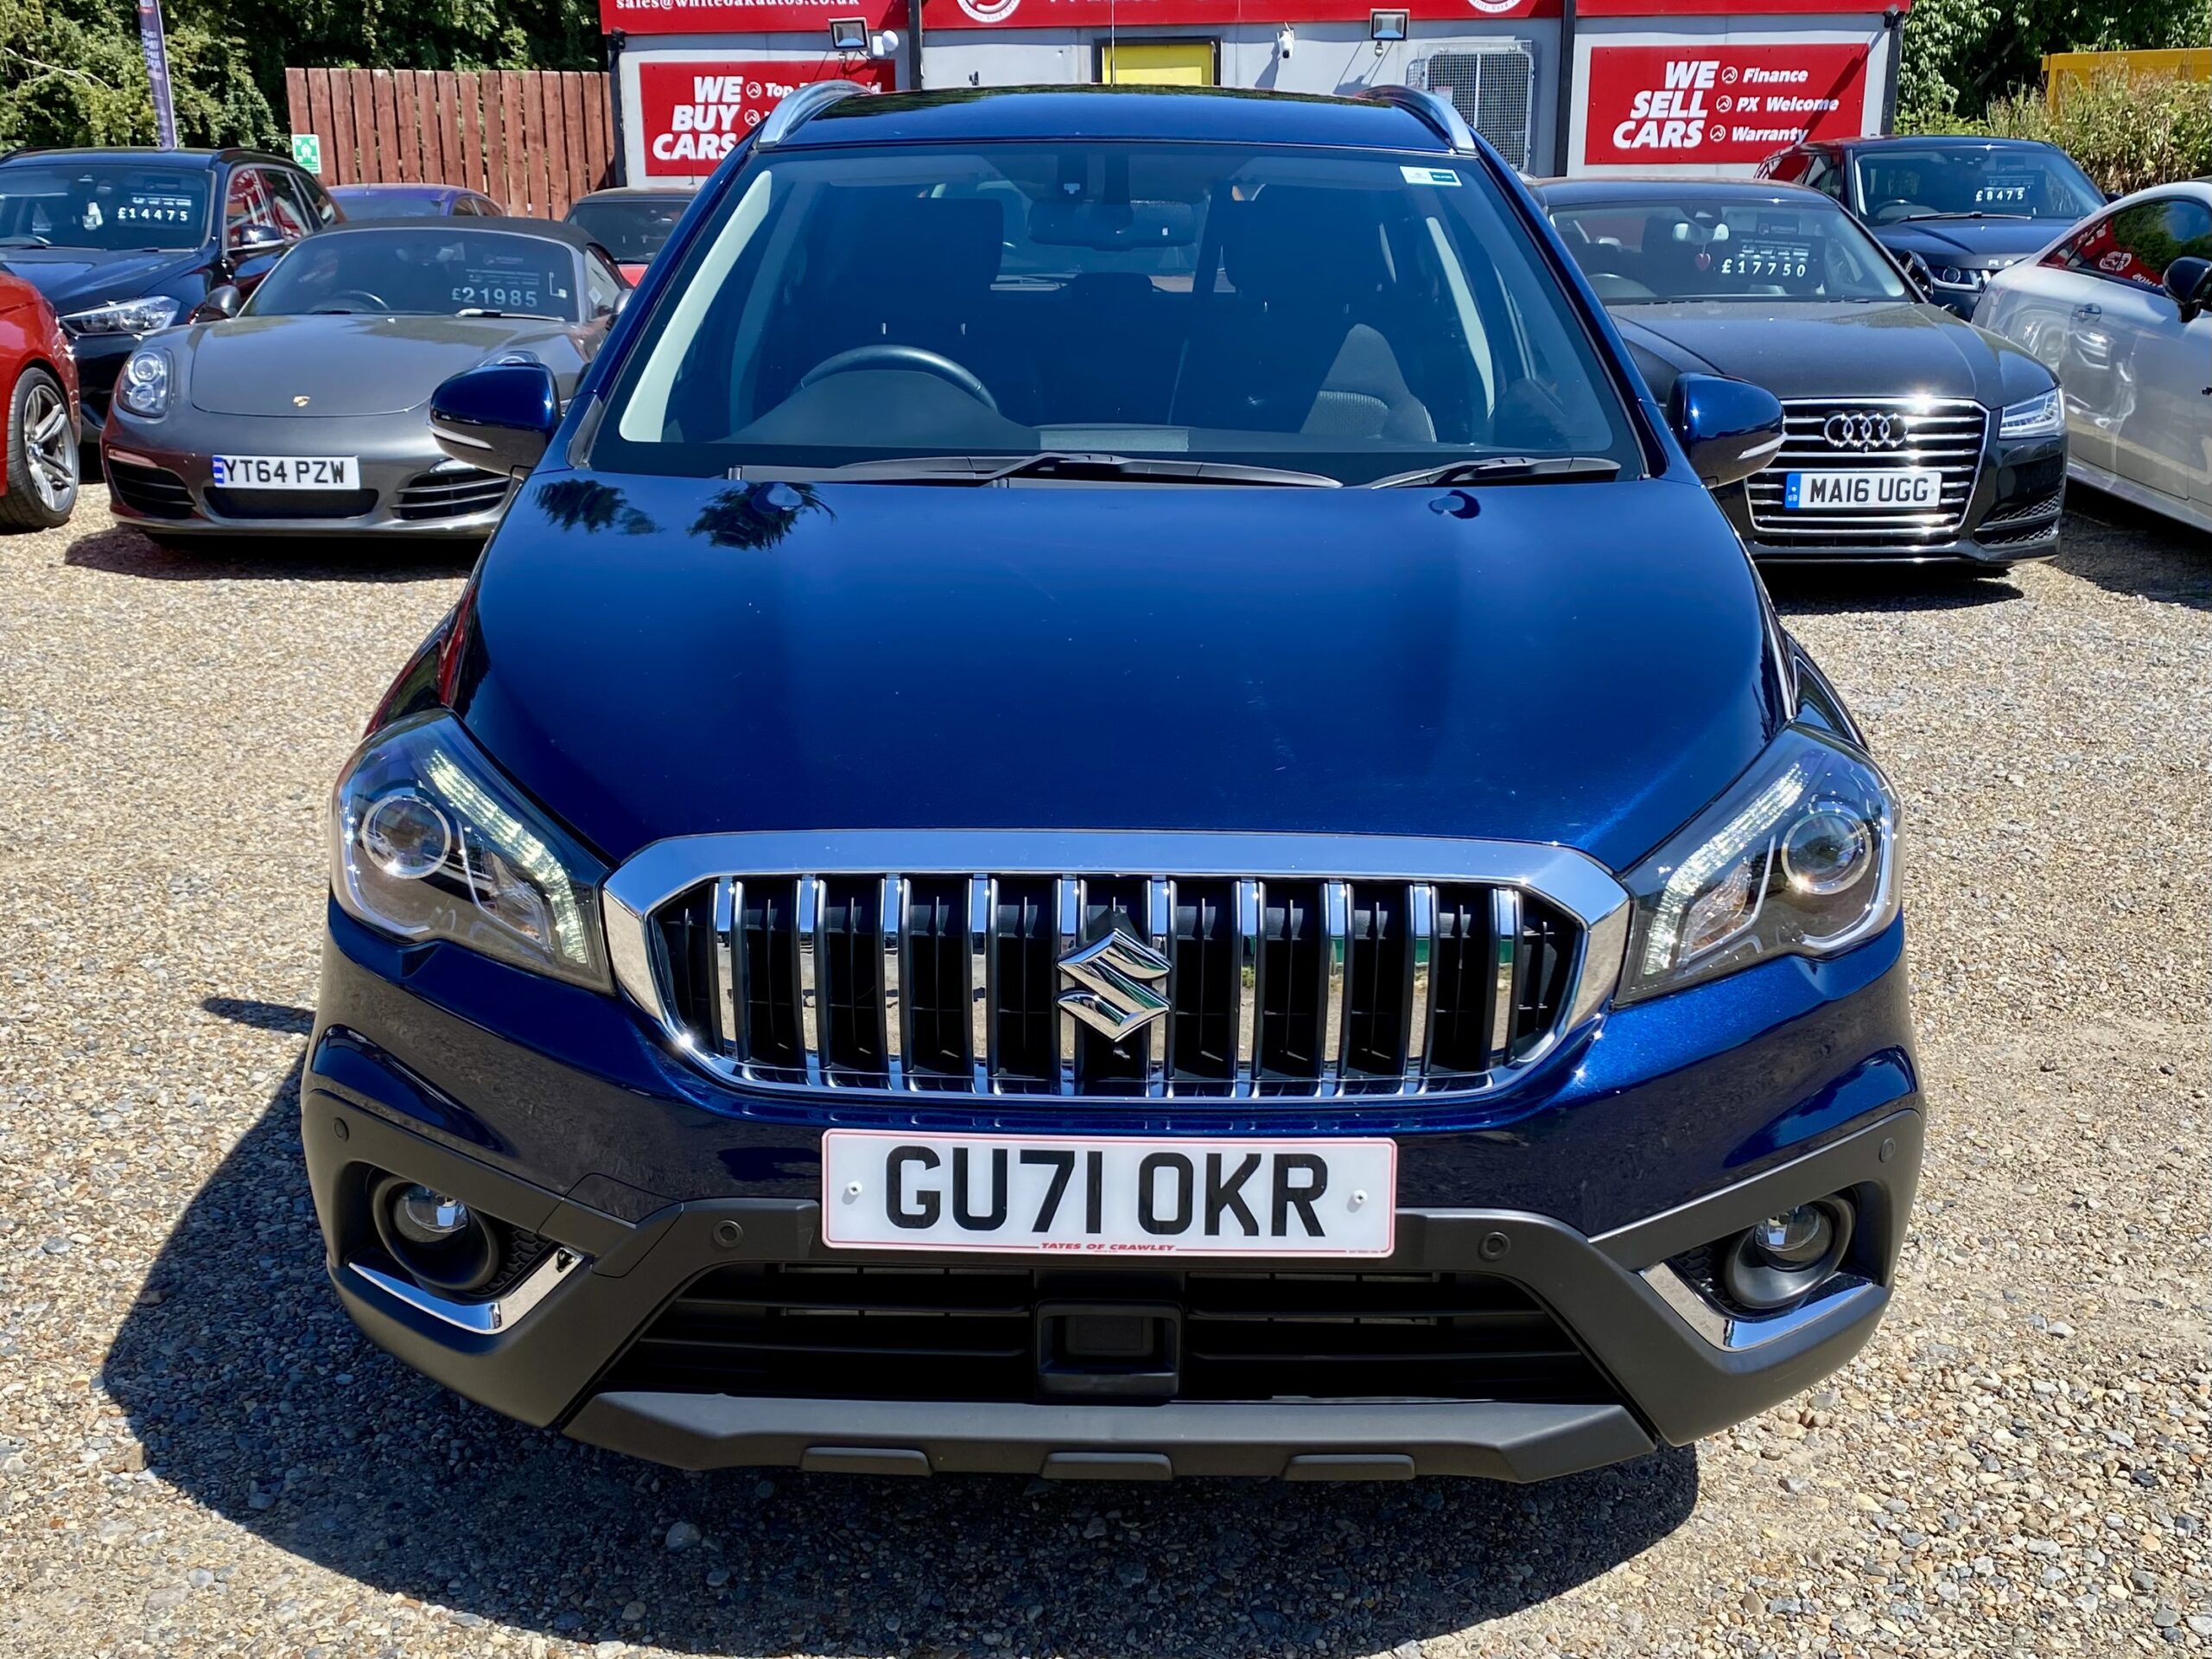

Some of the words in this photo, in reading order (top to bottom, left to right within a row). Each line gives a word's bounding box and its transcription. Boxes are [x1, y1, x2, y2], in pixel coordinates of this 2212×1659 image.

[1665, 61, 1719, 89] WE
[1742, 67, 1808, 83] Finance
[693, 76, 744, 103] WE
[765, 82, 794, 99] Top
[1630, 91, 1708, 118] SELL
[1736, 97, 1759, 111] PX
[1766, 97, 1840, 111] Welcome
[671, 105, 741, 131] BUY
[652, 133, 737, 160] CARS
[1612, 120, 1705, 149] CARS
[1732, 127, 1809, 145] Warranty
[1975, 190, 2024, 201] £8475
[118, 207, 188, 221] £14475
[1721, 258, 1806, 276] £17750
[451, 287, 537, 307] £21985
[224, 460, 287, 483] YT64
[296, 461, 344, 484] PZW
[1810, 478, 1870, 502] MA16
[1878, 478, 1929, 502] UGG
[886, 1146, 1103, 1234] GU71
[1138, 1152, 1325, 1237] OKR
